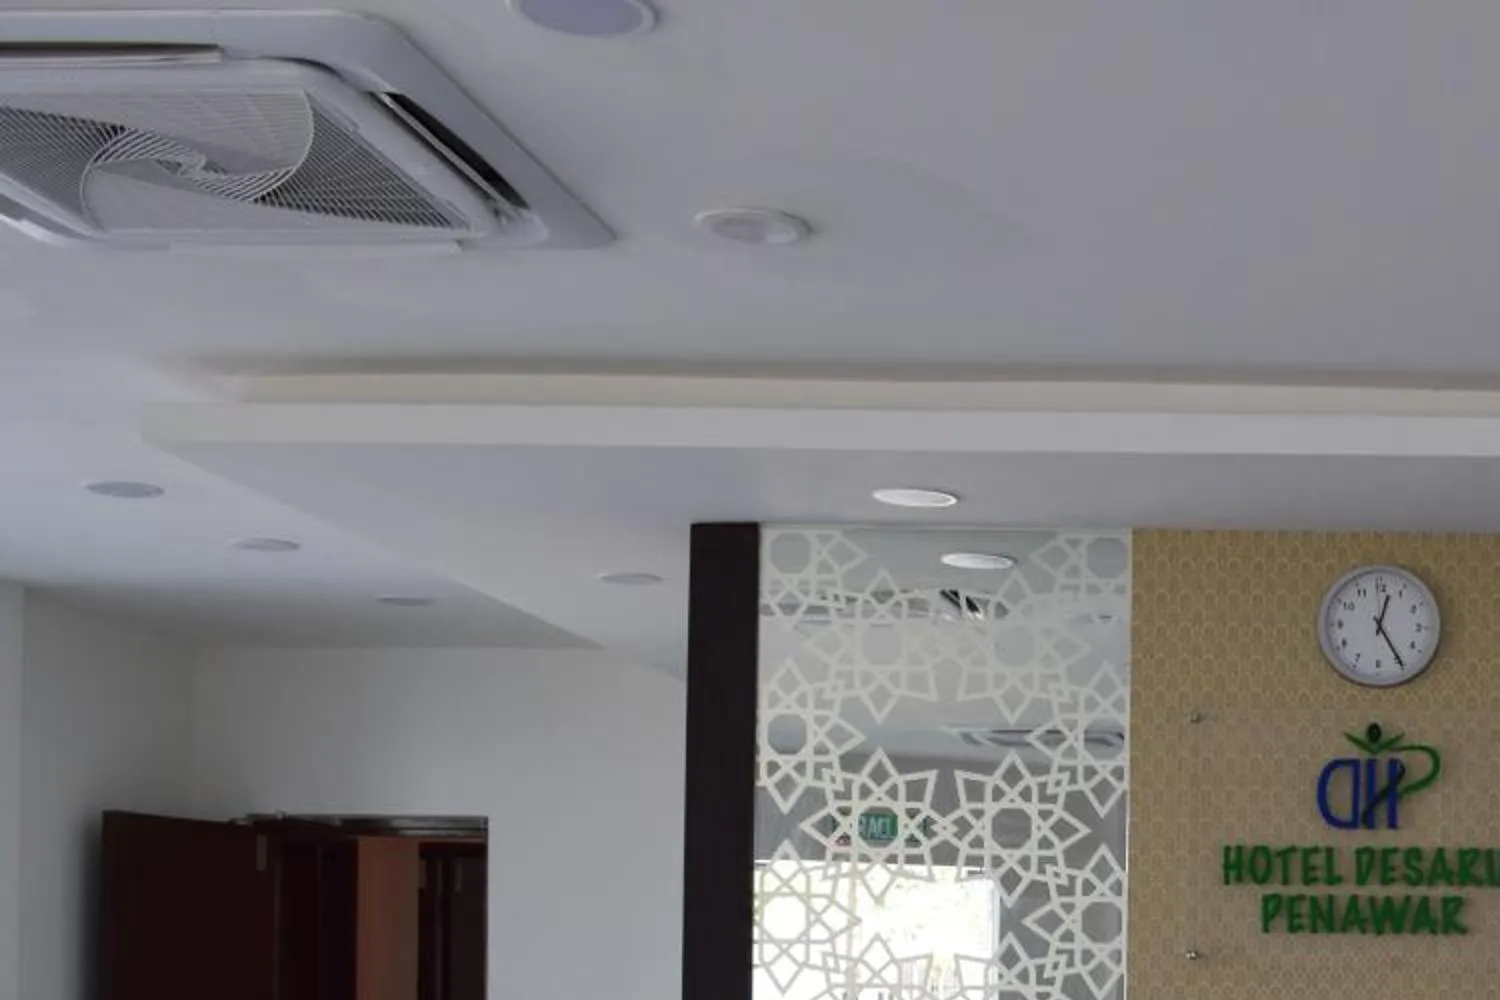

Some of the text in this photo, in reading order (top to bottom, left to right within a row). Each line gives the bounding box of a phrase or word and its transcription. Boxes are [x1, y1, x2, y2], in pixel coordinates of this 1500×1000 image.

[1343, 601, 1355, 611] 10
[1222, 845, 1343, 887] HOTEL
[1260, 893, 1468, 935] PENAWAR
